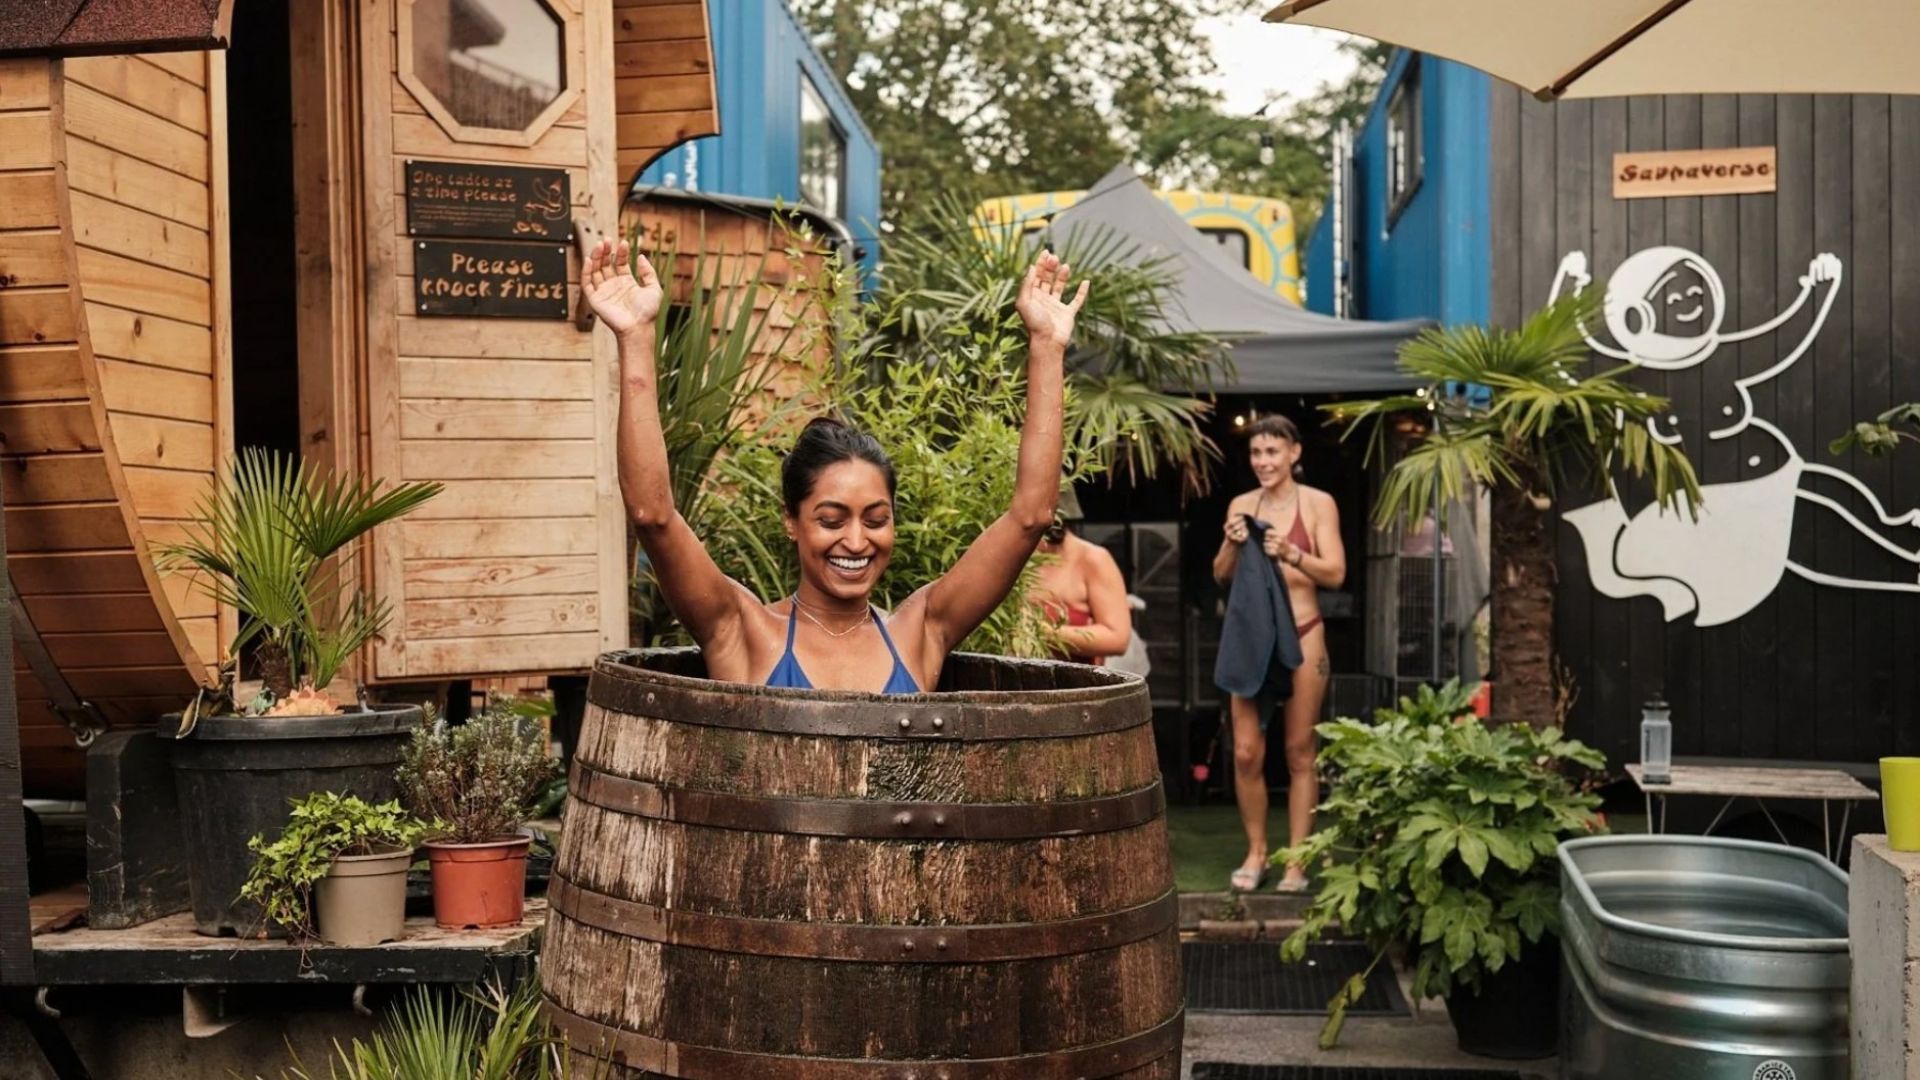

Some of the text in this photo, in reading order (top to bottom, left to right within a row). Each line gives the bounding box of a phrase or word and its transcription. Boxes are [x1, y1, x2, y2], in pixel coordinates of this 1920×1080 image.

[413, 170, 513, 188] One ladle at
[1619, 163, 1770, 183] Saunaverse
[411, 187, 420, 197] a
[425, 187, 459, 199] time
[452, 252, 534, 275] Please
[500, 277, 564, 299] first
